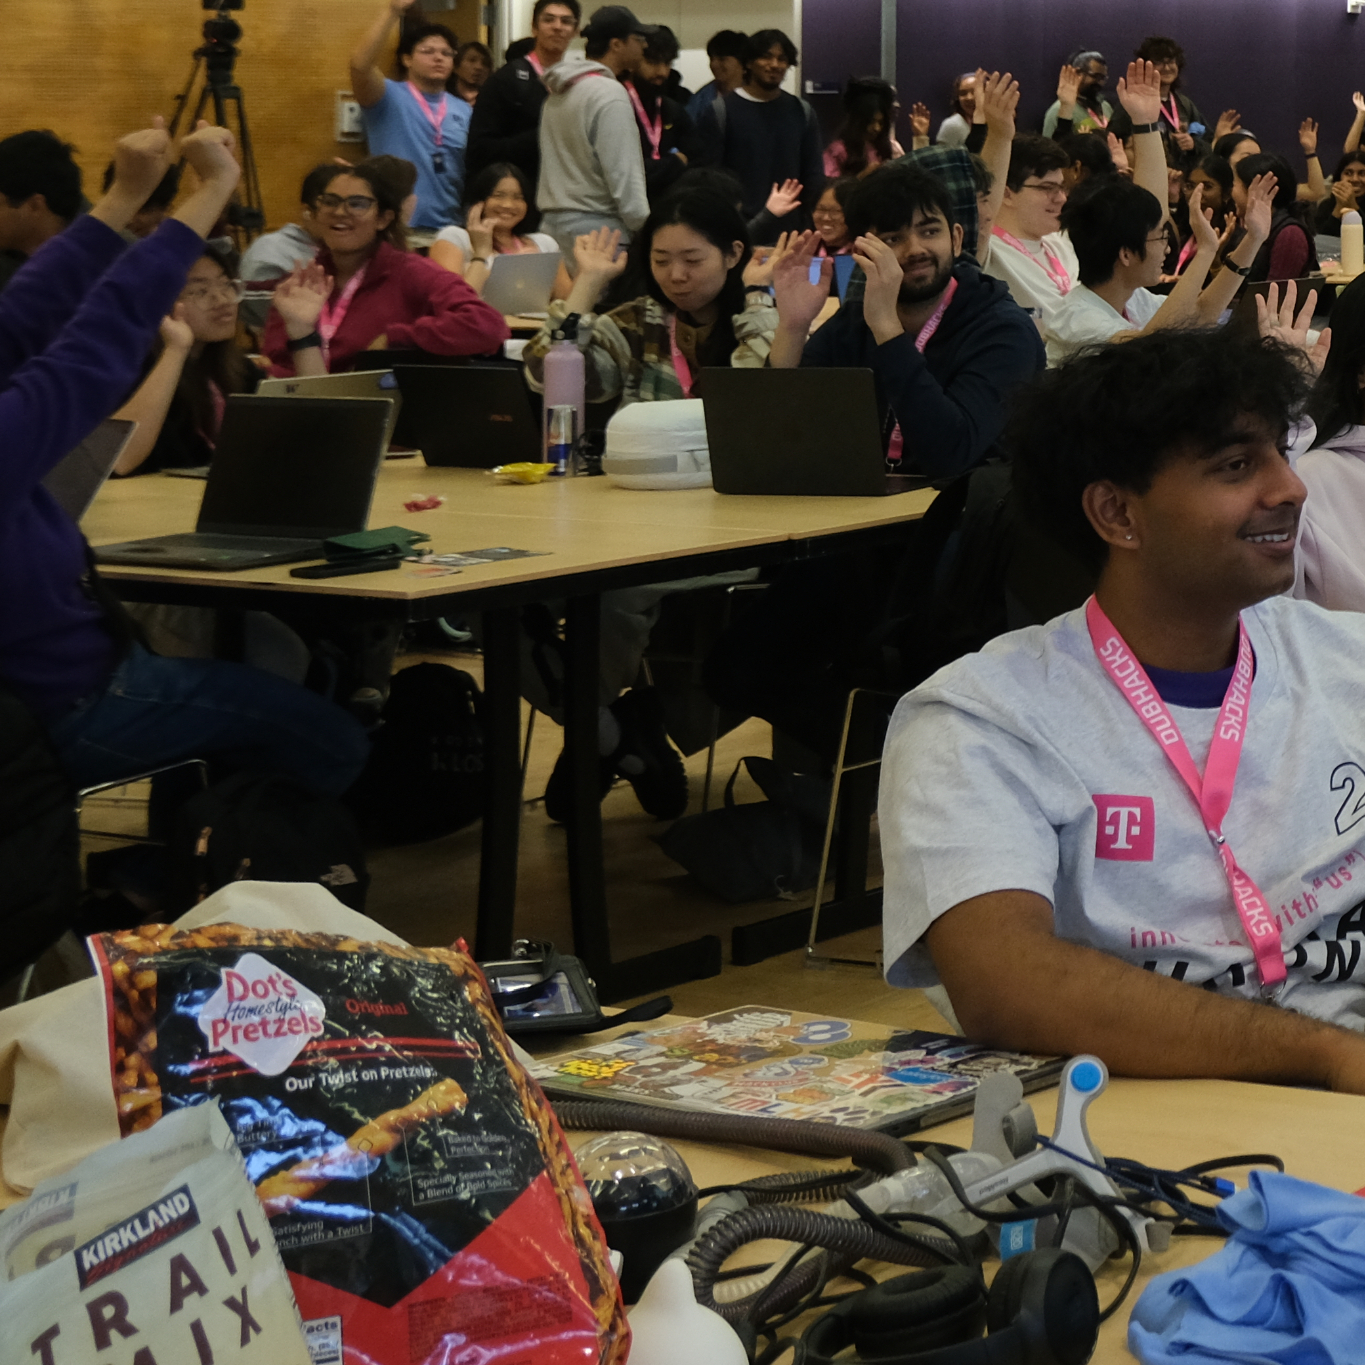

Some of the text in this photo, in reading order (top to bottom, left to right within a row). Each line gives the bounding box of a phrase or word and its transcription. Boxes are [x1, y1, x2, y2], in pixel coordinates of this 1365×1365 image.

[1100, 637, 1179, 745] DUBHACKS
[1105, 807, 1141, 849] T
[225, 970, 298, 1003] Dot's
[345, 998, 409, 1016] Original
[211, 1008, 323, 1048] Pretzels
[285, 1077, 315, 1092] Our
[319, 1071, 359, 1085] Twist
[362, 1069, 378, 1080] on
[427, 1186, 447, 1198] Blend
[81, 1191, 191, 1271] KIRKLAND
[300, 1231, 326, 1244] with
[327, 1231, 334, 1239] a
[337, 1223, 364, 1235] Twist
[304, 1321, 339, 1334] acts
